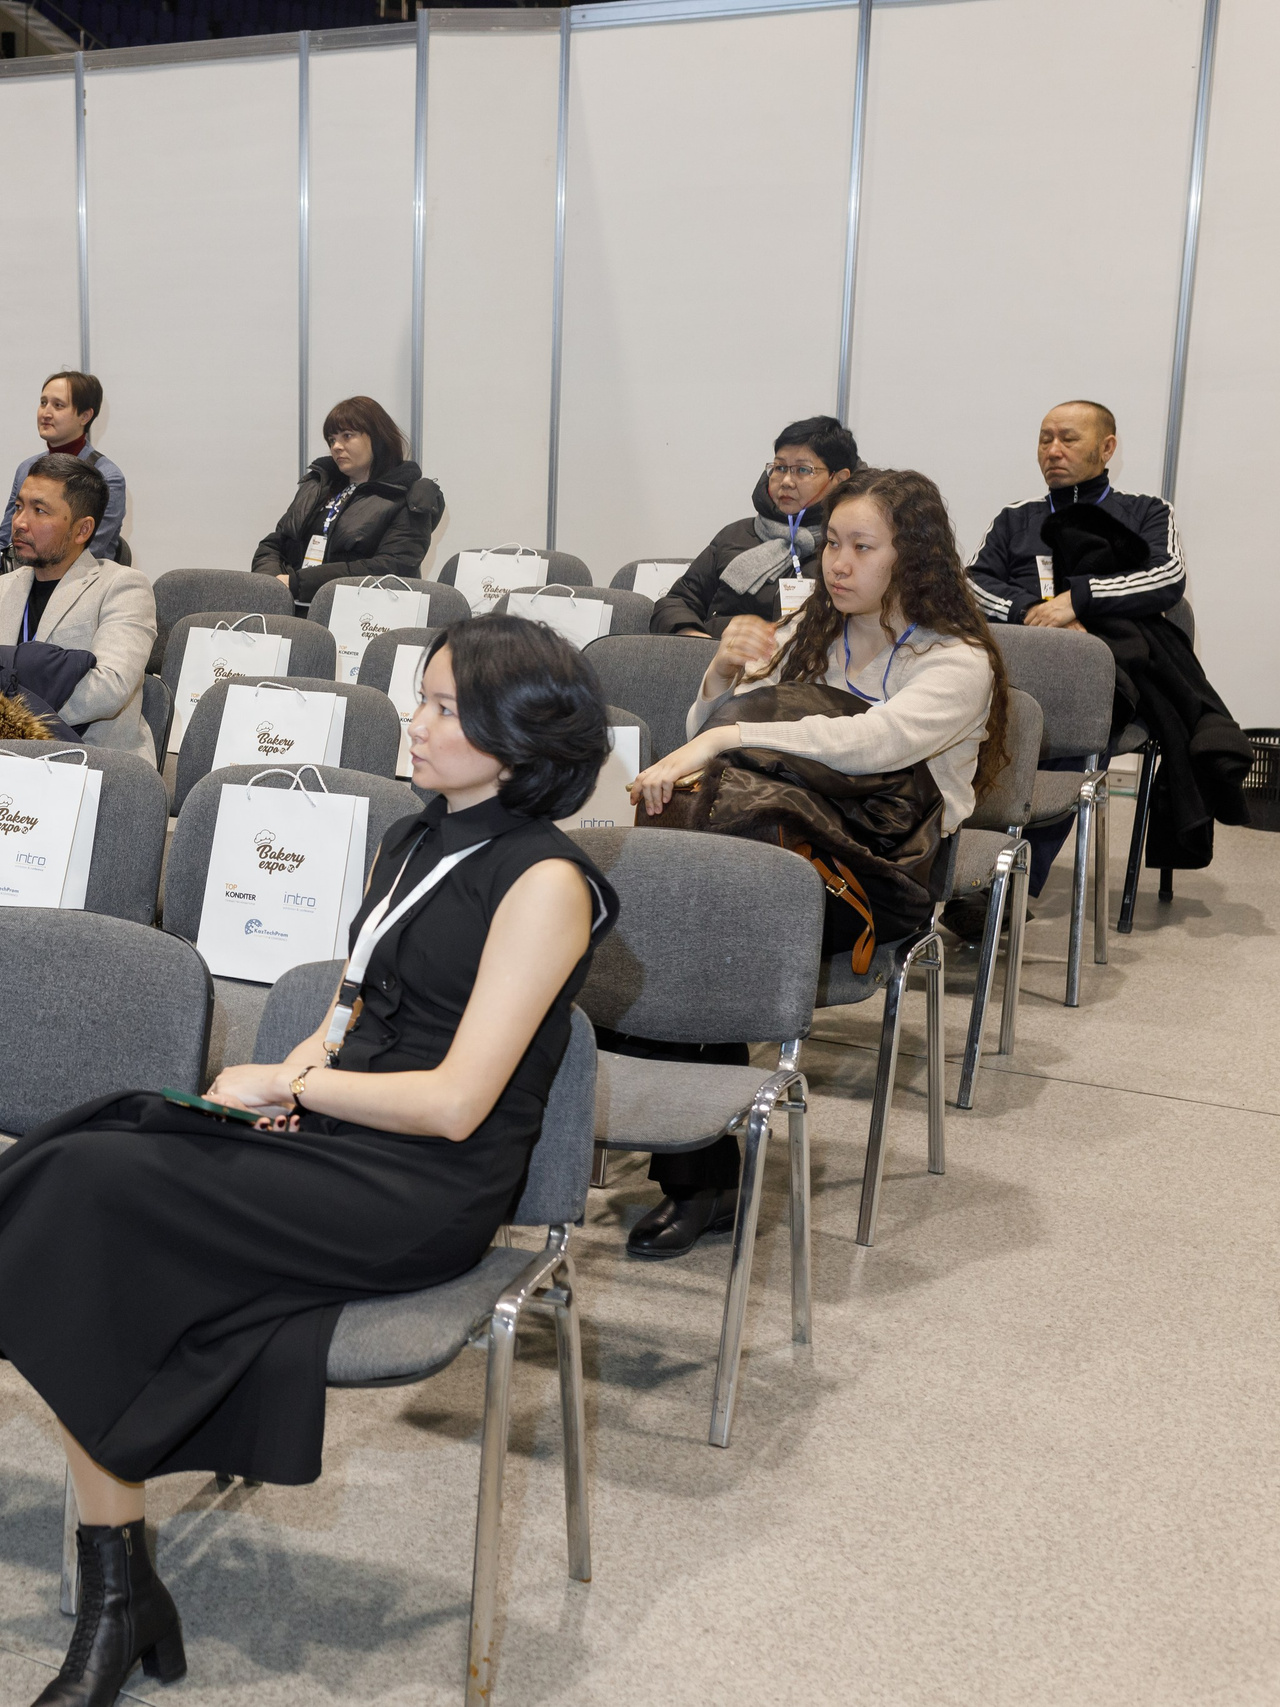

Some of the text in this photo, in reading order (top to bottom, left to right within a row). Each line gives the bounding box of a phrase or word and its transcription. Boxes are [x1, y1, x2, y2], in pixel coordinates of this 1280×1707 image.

[257, 732, 295, 750] Bakery
[258, 744, 280, 756] expo
[580, 817, 615, 828] intro
[15, 850, 47, 866] intro
[256, 844, 306, 869] Bakery
[258, 860, 287, 875] expo
[224, 890, 257, 901] KONDITER
[283, 891, 316, 907] intro
